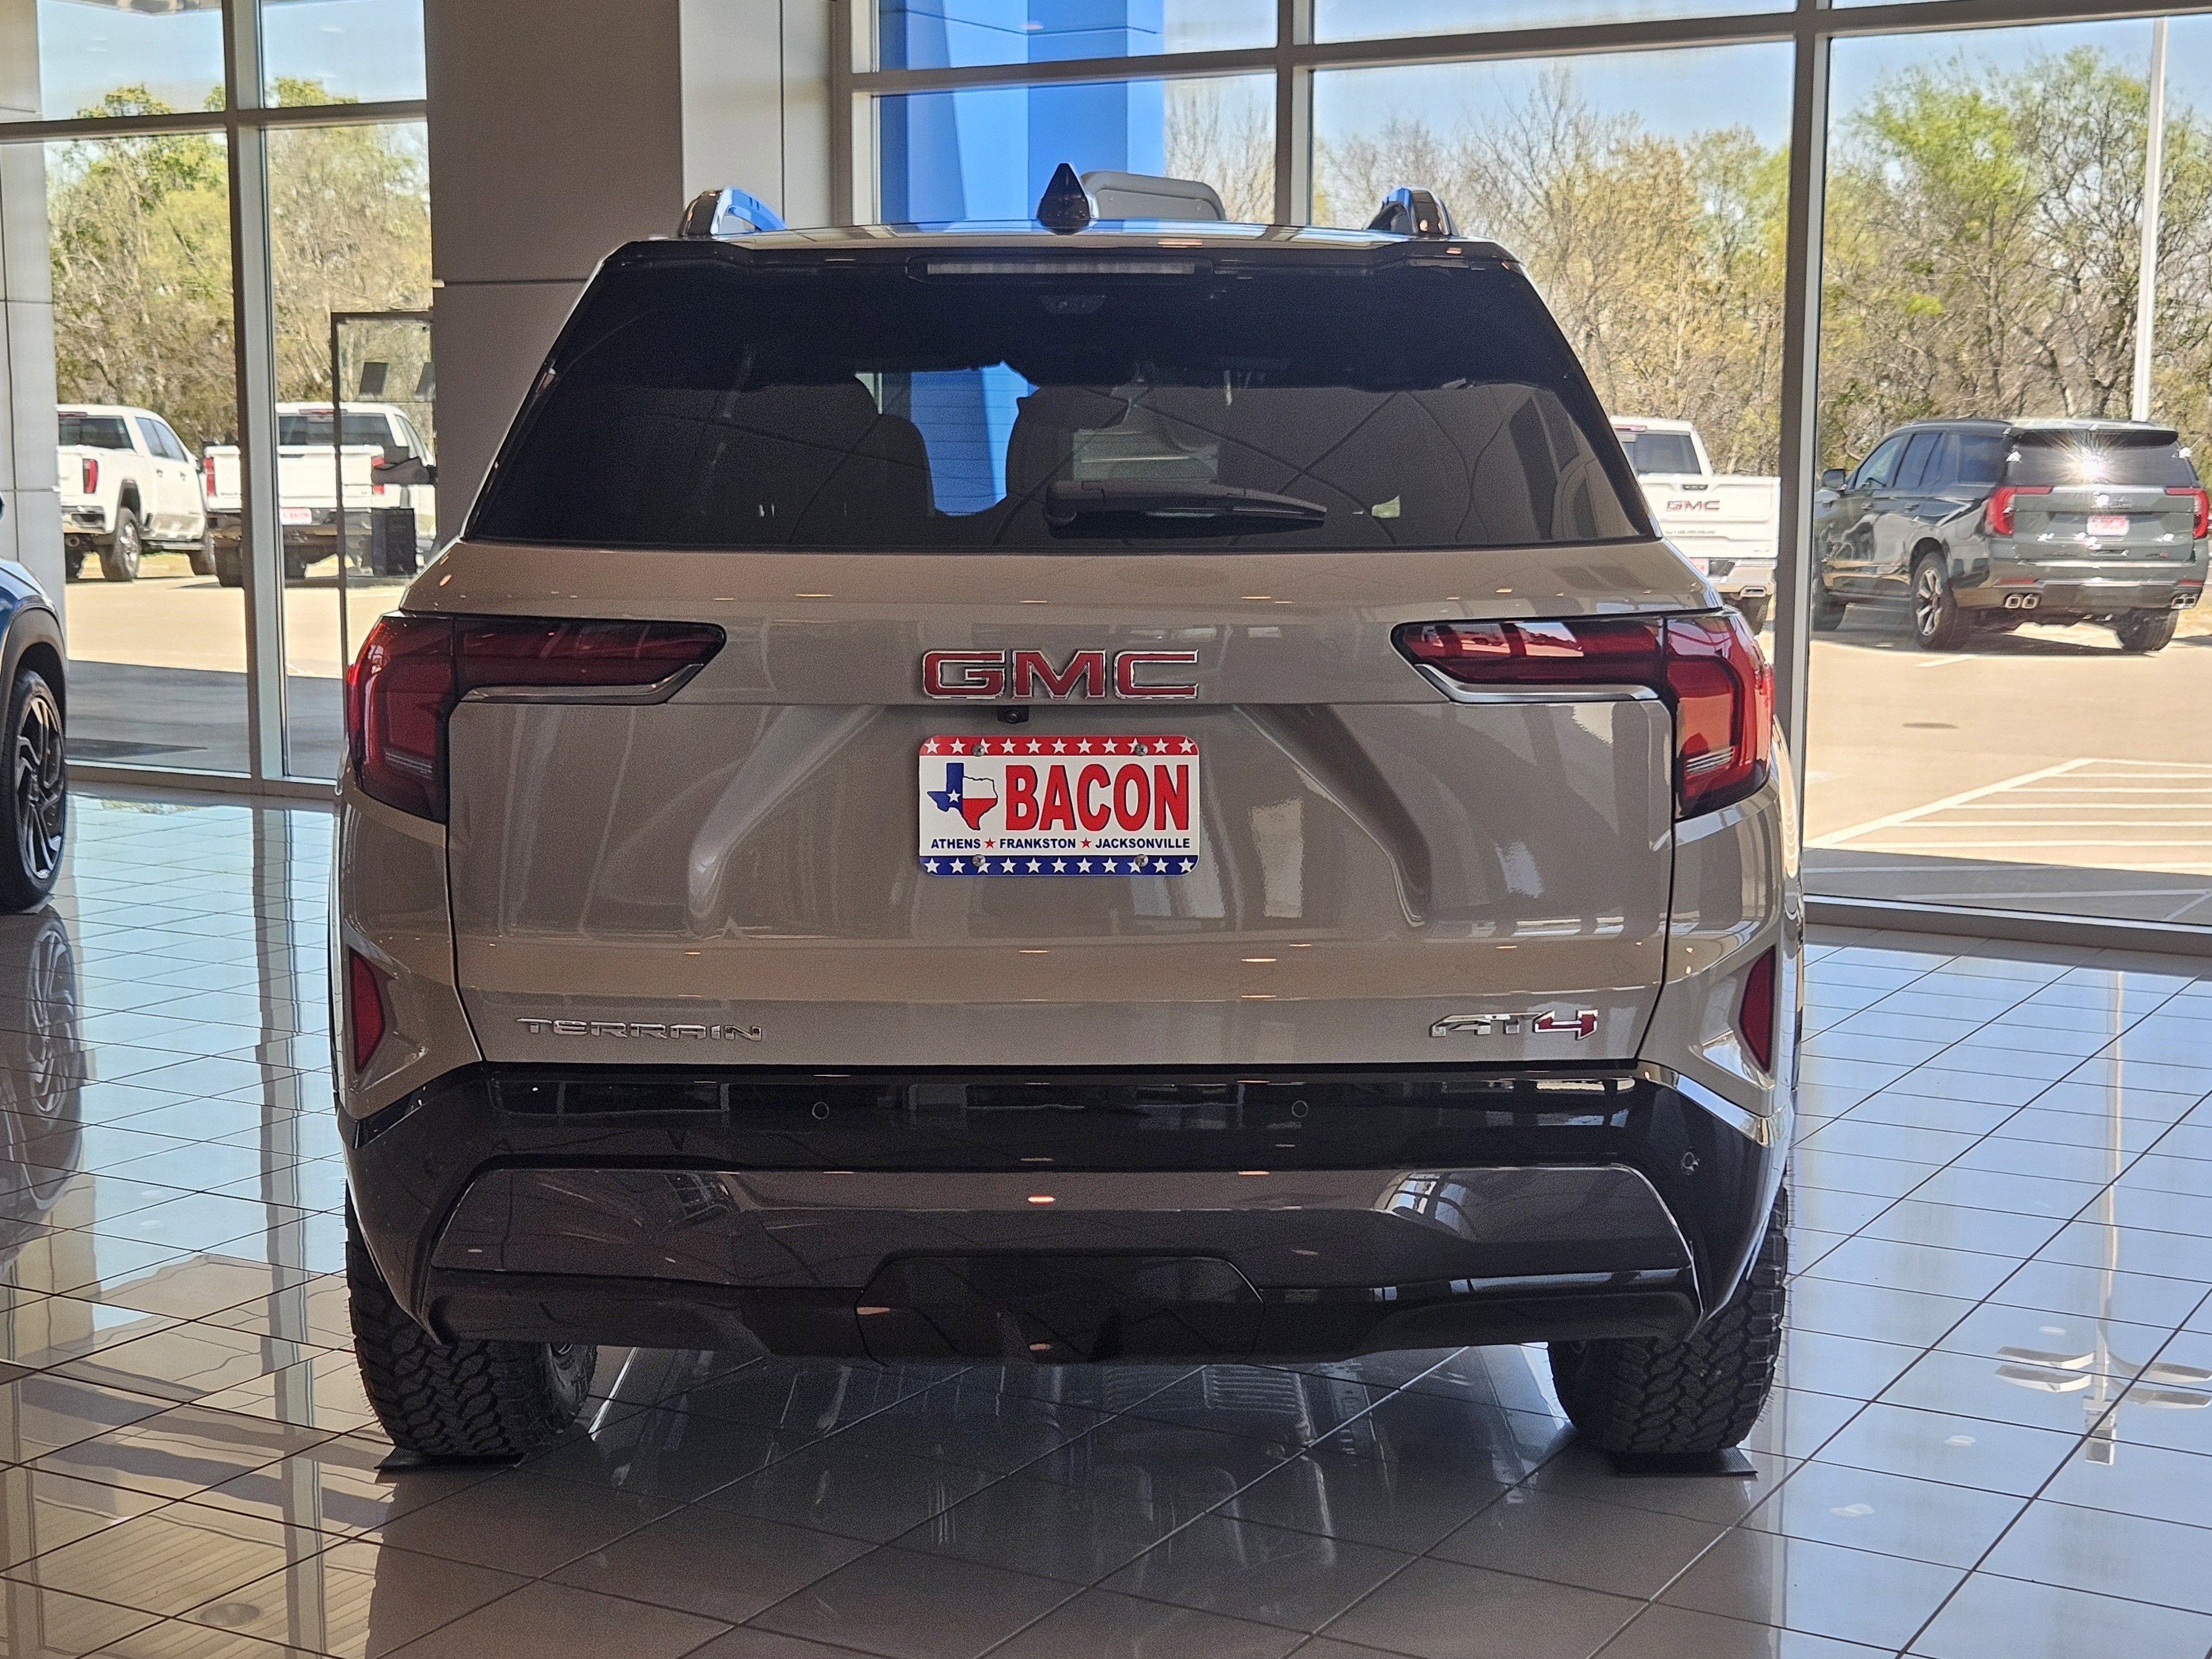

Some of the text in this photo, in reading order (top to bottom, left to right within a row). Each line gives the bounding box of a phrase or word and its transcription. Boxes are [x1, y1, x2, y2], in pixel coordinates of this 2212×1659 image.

[1667, 500, 1721, 512] GMC
[923, 649, 1200, 700] GMC
[1005, 763, 1189, 832] BACON
[931, 837, 1191, 850] ATHENS FRANKSTON JACKSONVILLE
[517, 1017, 763, 1042] TERRAIN
[1430, 1009, 1599, 1041] AT4
